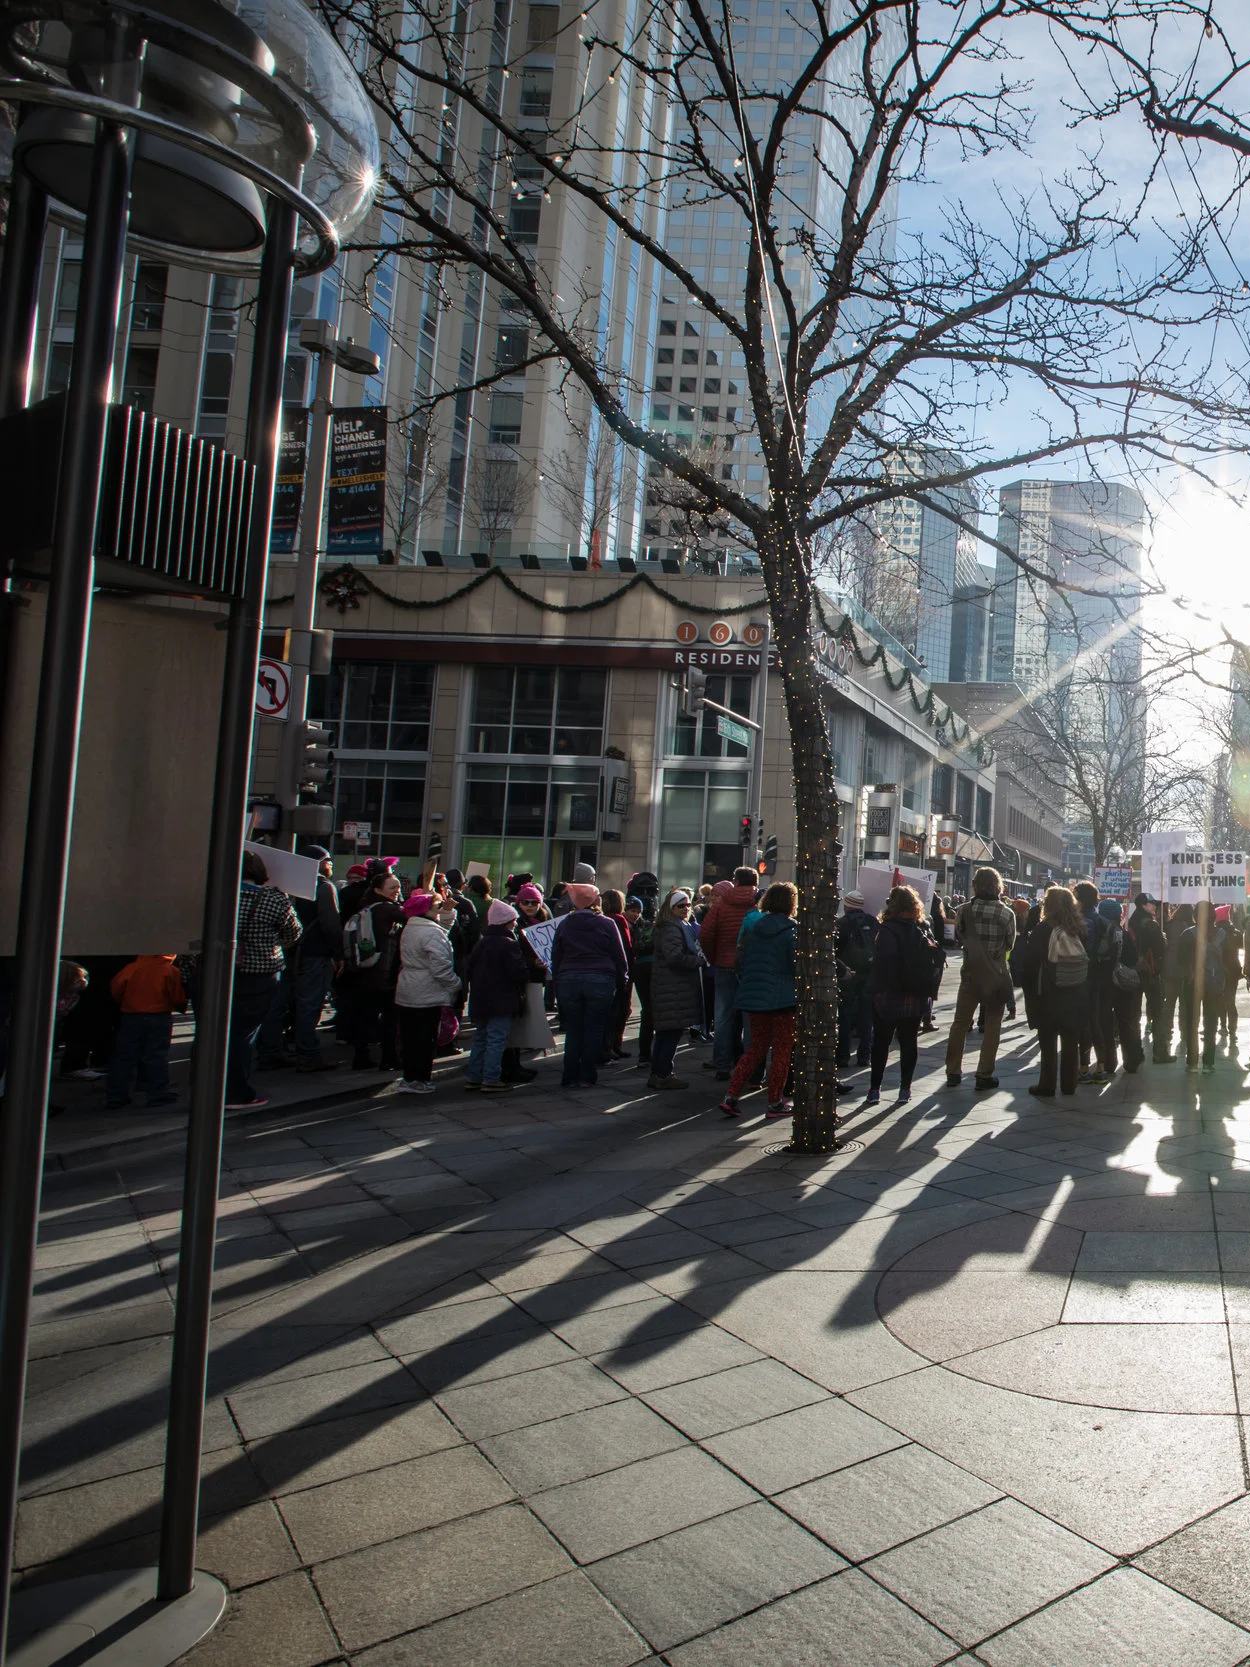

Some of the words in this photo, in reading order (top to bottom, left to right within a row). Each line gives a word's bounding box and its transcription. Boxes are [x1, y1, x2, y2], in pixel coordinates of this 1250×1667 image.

[334, 420, 363, 434] HELP
[334, 430, 376, 444] CHANGE
[334, 439, 386, 452] HOMELESSNESS
[337, 467, 360, 477] TEXT
[349, 483, 376, 494] 41444
[684, 626, 759, 642] 160
[675, 652, 776, 666] RESIDENC
[1171, 853, 1243, 865] KINDNESS
[1201, 864, 1215, 875] IS
[1170, 876, 1245, 888] EVERYTHING
